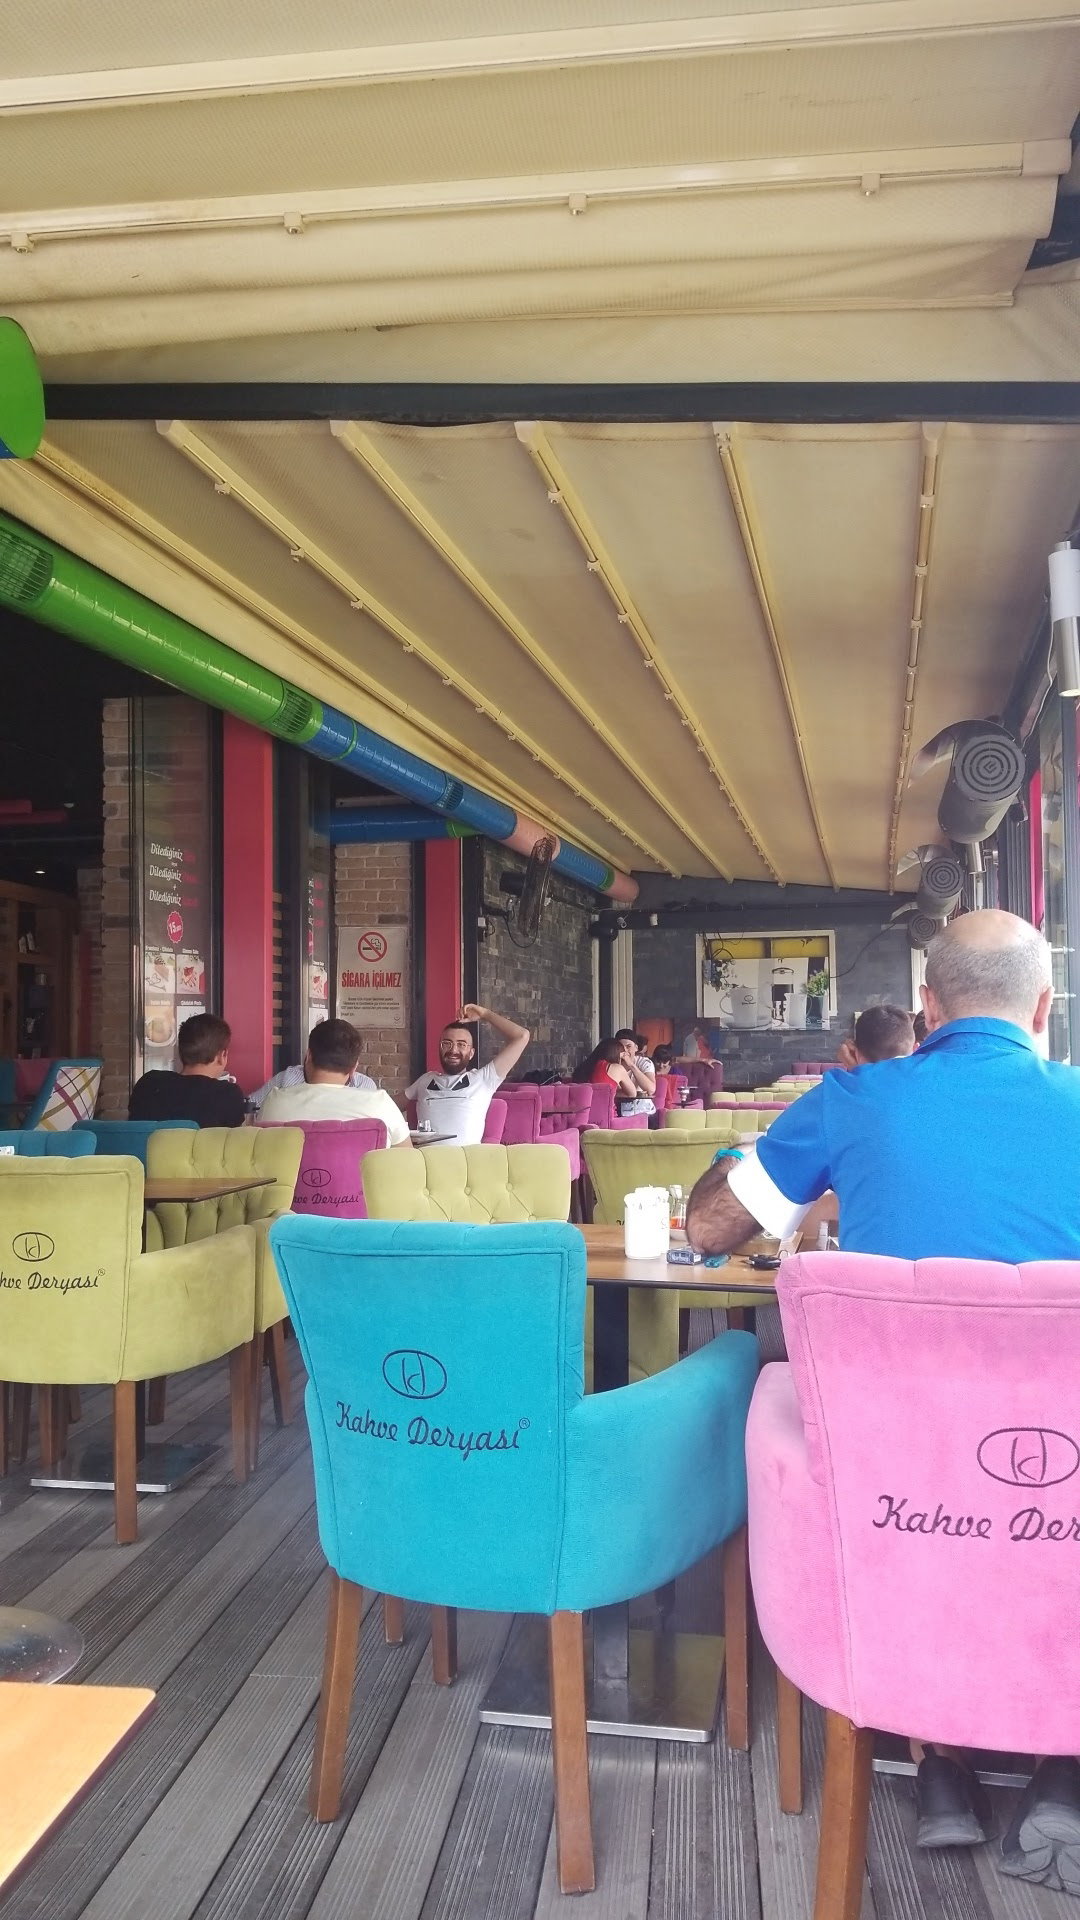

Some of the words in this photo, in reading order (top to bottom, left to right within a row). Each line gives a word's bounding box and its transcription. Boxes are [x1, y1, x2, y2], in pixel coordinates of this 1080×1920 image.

[341, 969, 371, 988] SİGARA
[372, 969, 402, 990] İÇİLMEZ
[335, 1400, 399, 1442] Kahve
[871, 1494, 992, 1540] Kahve
